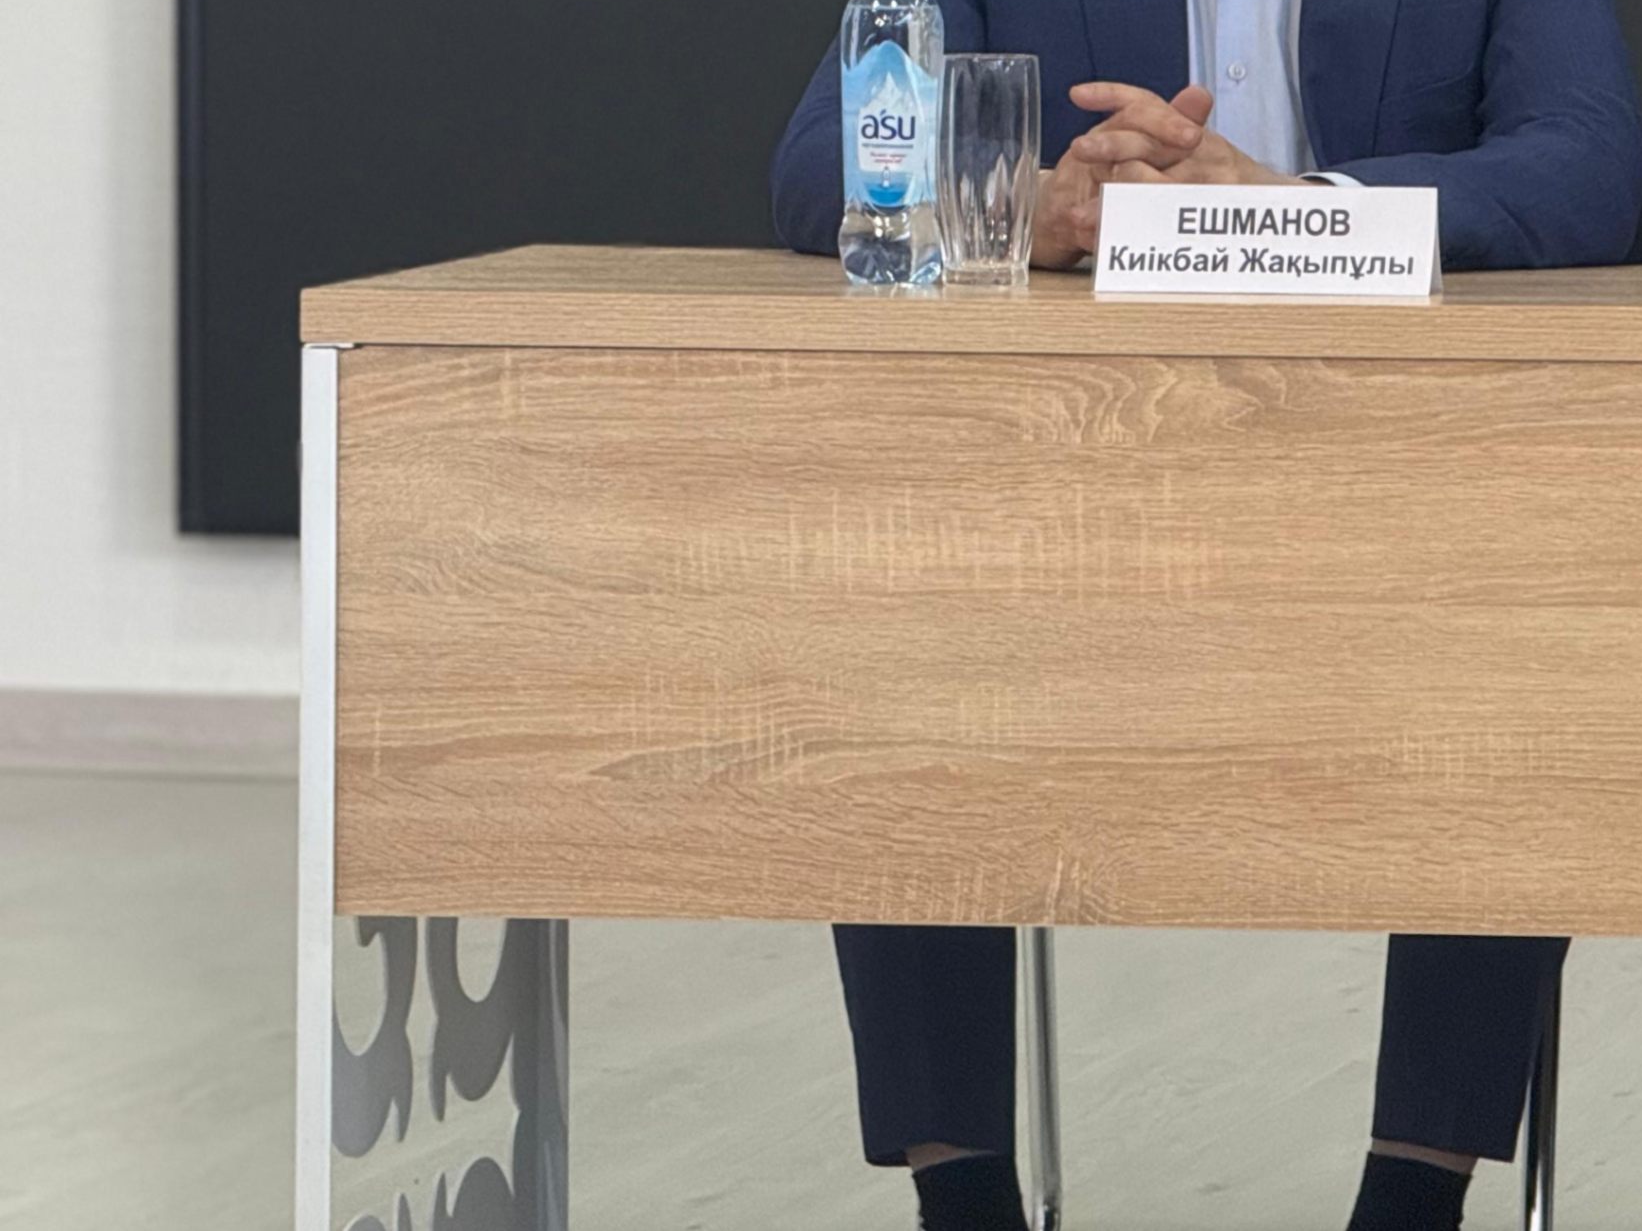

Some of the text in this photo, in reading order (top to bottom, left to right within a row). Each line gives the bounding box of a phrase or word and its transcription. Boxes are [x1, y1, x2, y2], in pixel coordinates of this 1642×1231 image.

[1177, 207, 1351, 237] ЕШМАНОВ
[1108, 245, 1415, 281] Киікбай Жақыпұлы
